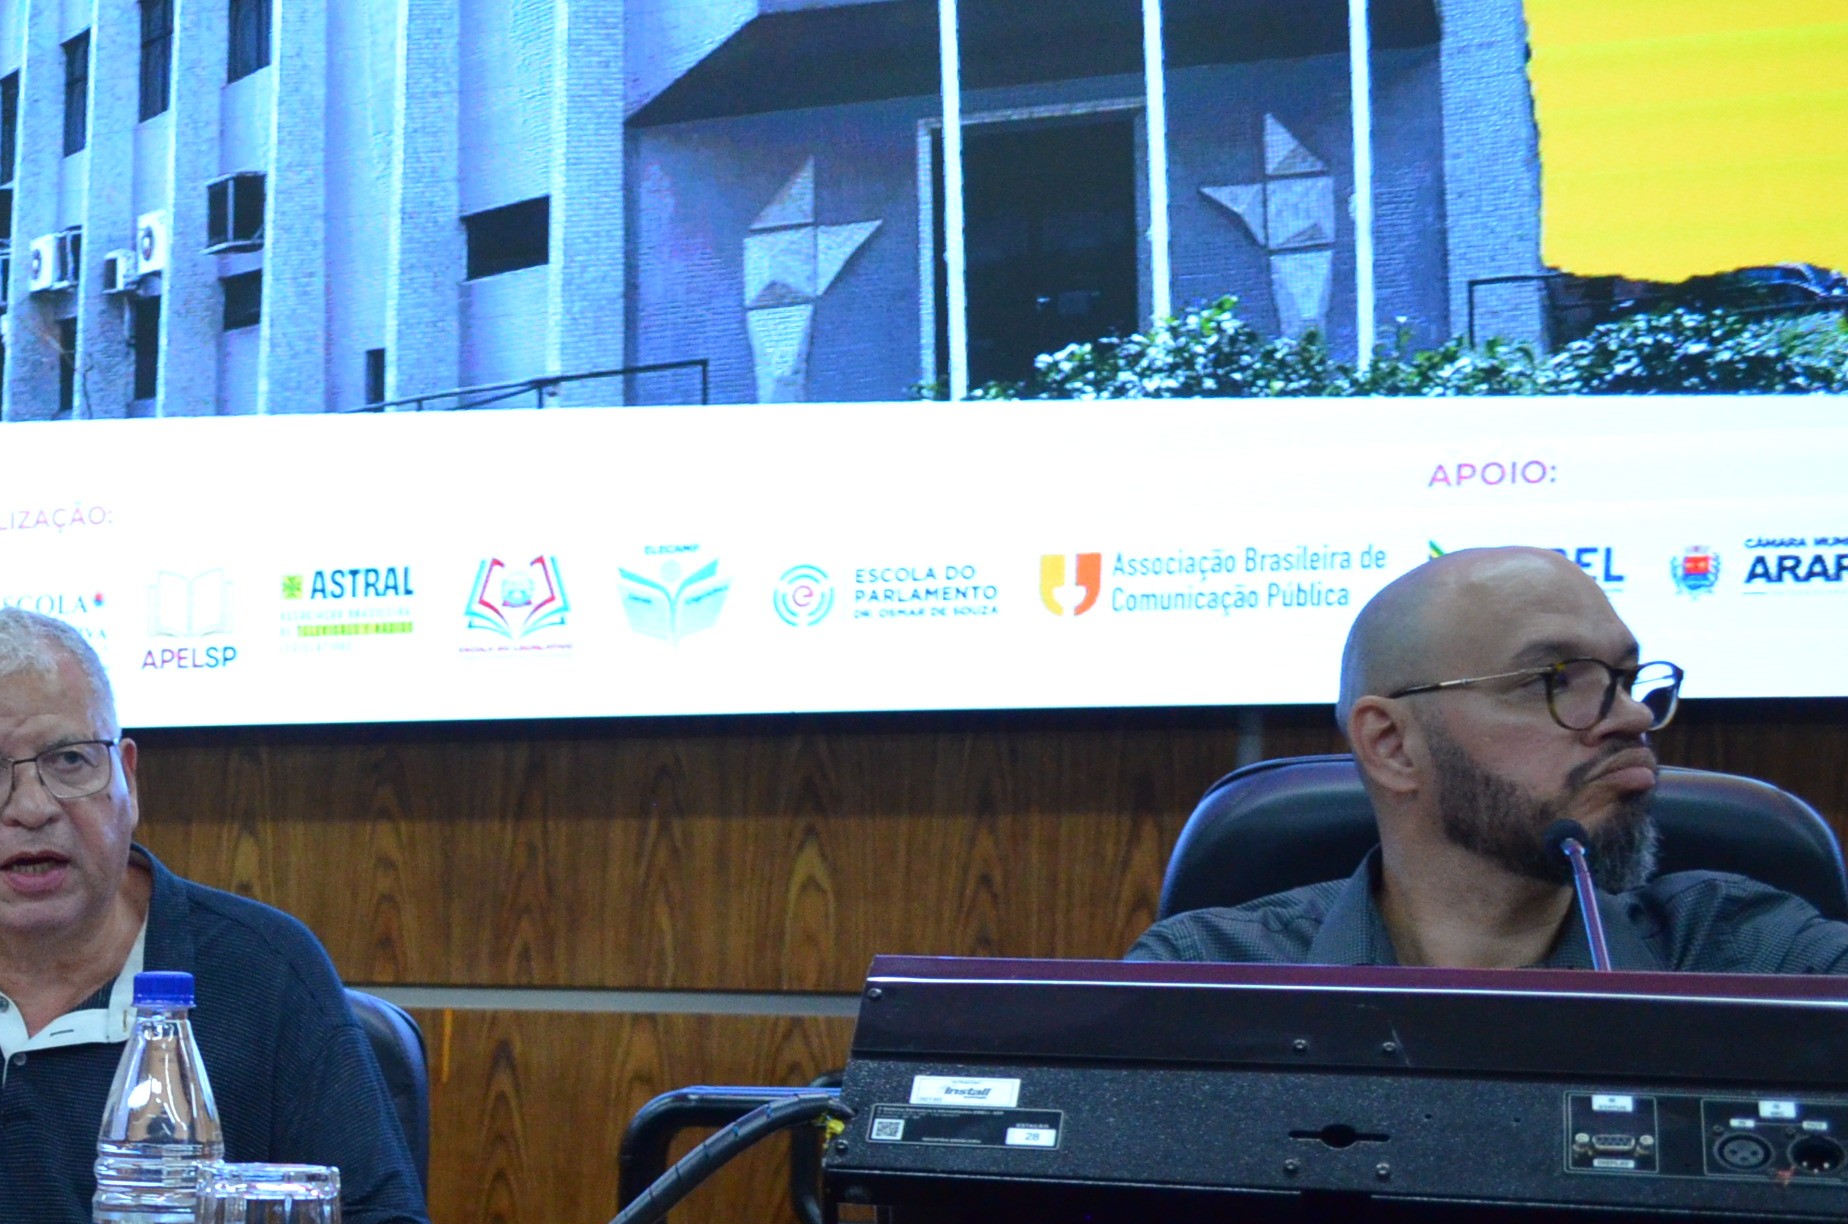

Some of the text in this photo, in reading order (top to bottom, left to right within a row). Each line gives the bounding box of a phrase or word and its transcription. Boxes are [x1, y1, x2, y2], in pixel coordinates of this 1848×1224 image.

[1428, 459, 1556, 487] APOIO:
[855, 565, 975, 584] ESCOLA DO
[1113, 544, 1386, 582] Associação Brasileira de
[310, 566, 414, 600] ASTRAL
[855, 585, 998, 603] PARLAMENTO
[1112, 582, 1350, 616] Comunicação Pública
[141, 646, 238, 670] APELSP
[1024, 1131, 1040, 1142] 28
